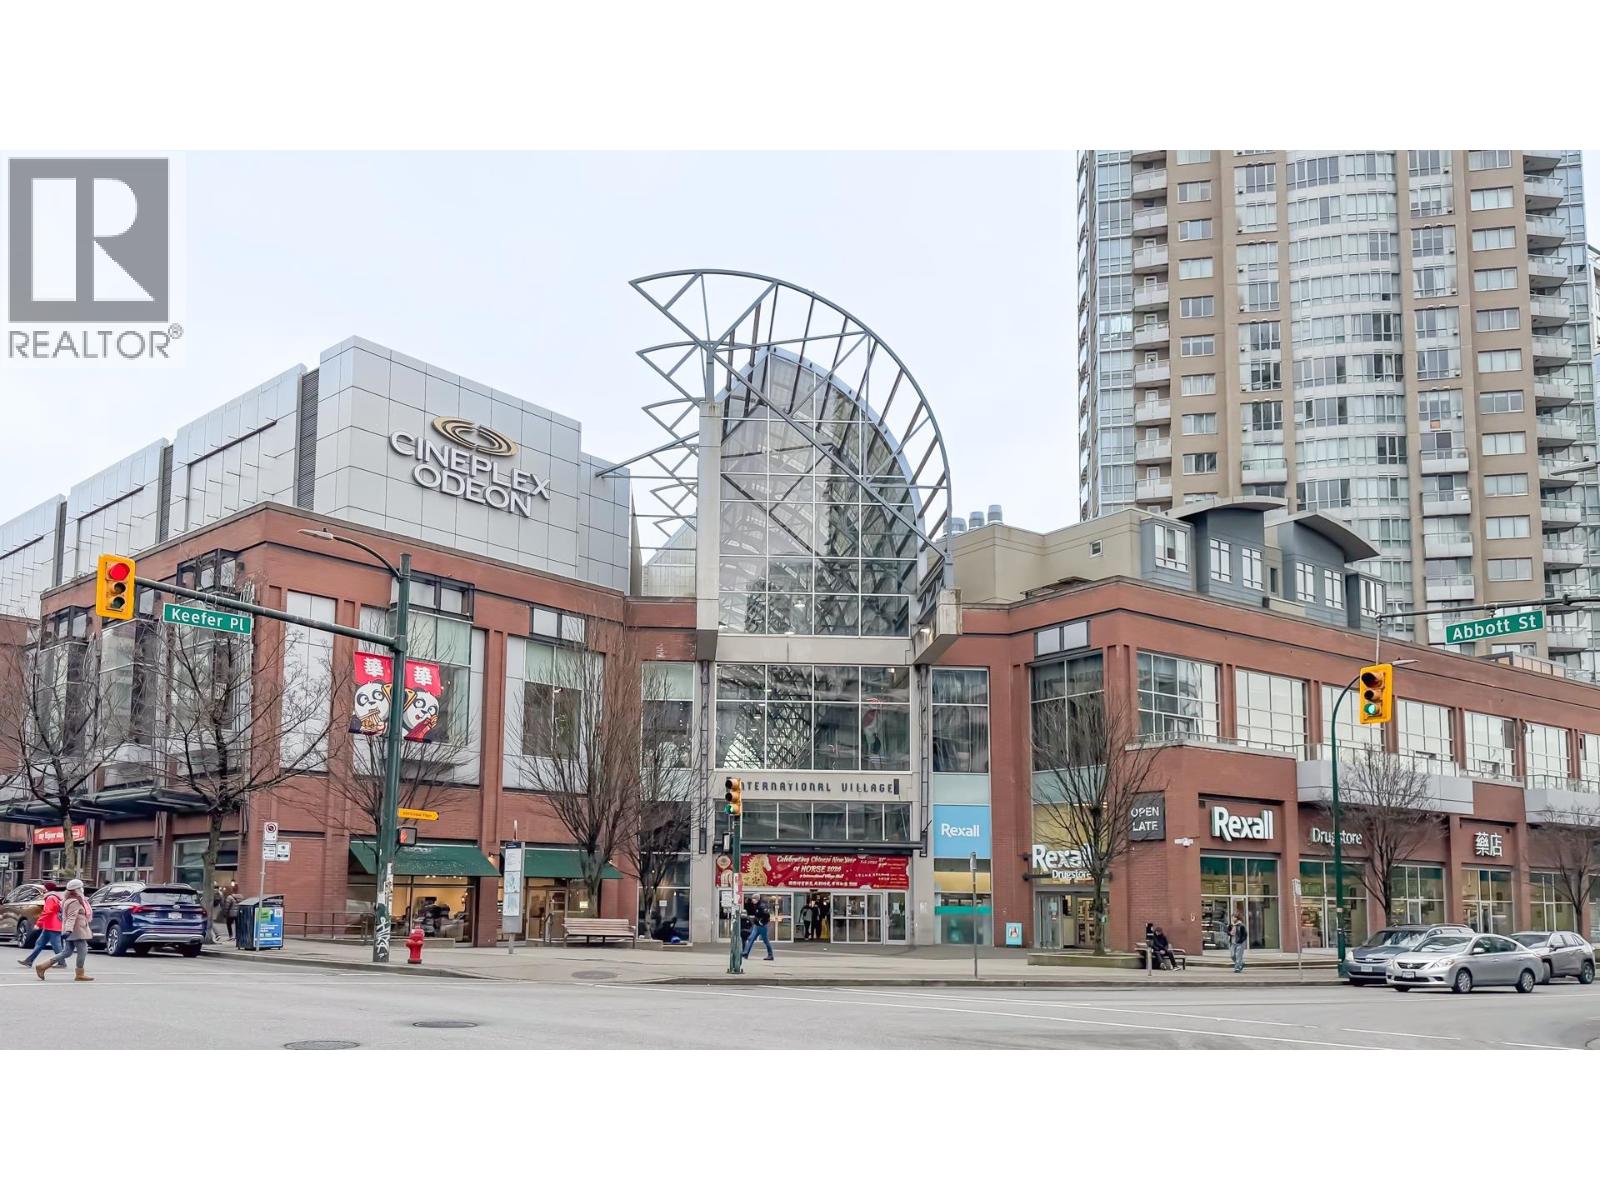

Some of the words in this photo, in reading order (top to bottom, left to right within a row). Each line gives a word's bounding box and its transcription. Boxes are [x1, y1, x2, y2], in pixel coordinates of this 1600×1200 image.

[389, 431, 550, 500] CINEPLEX
[412, 464, 532, 517] ODEON
[172, 608, 223, 627] Keefer
[230, 617, 244, 631] Pl
[1453, 619, 1511, 640] Abbott
[1518, 615, 1536, 630] St
[841, 783, 893, 793] VILLAGE
[1130, 807, 1160, 818] OPEN
[1211, 806, 1274, 842] Rexall
[941, 823, 980, 838] Rexall
[1132, 821, 1159, 832] LATE
[1312, 827, 1362, 847] Drugtore
[1474, 832, 1503, 857] 藥店
